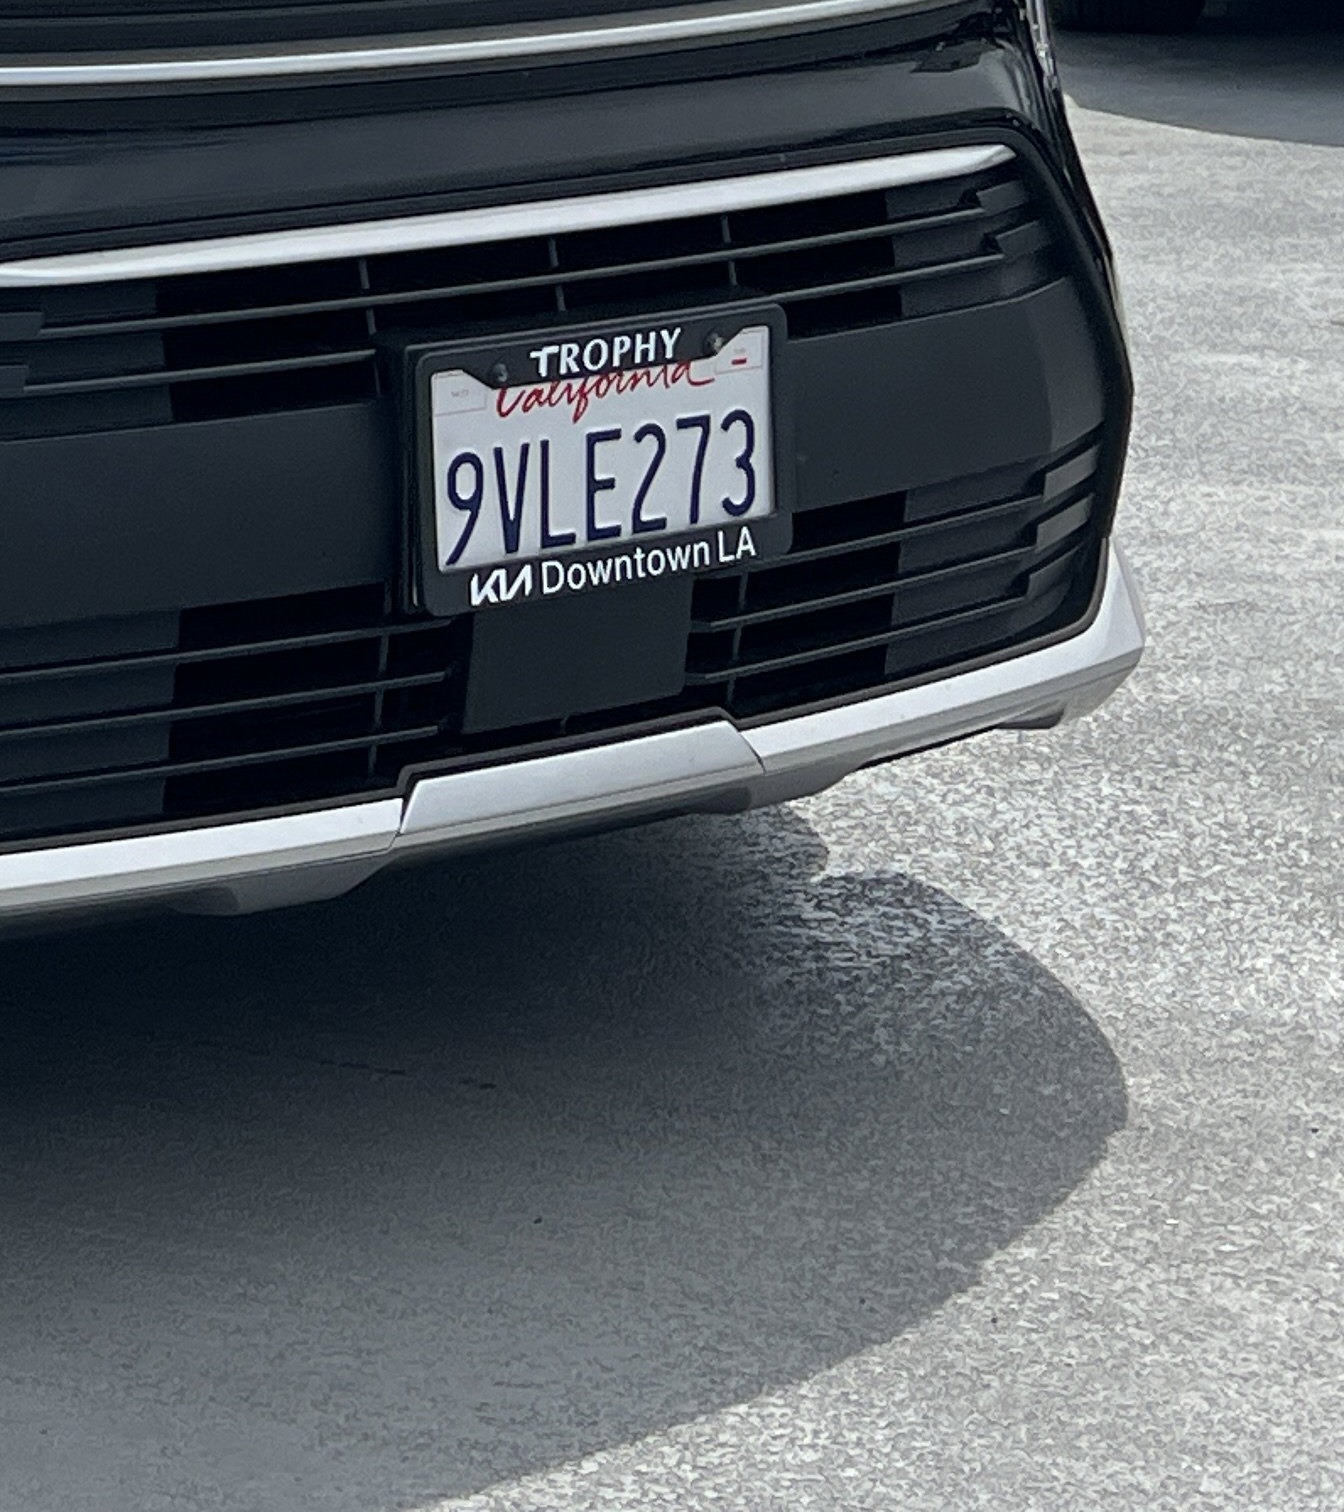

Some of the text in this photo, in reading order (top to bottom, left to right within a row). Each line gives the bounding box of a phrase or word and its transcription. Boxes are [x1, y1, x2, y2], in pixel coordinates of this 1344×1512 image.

[529, 327, 682, 377] TROPHY
[495, 359, 715, 423] California
[445, 409, 757, 566] 9VLE273
[541, 537, 711, 594] Downtown
[717, 525, 757, 563] LA
